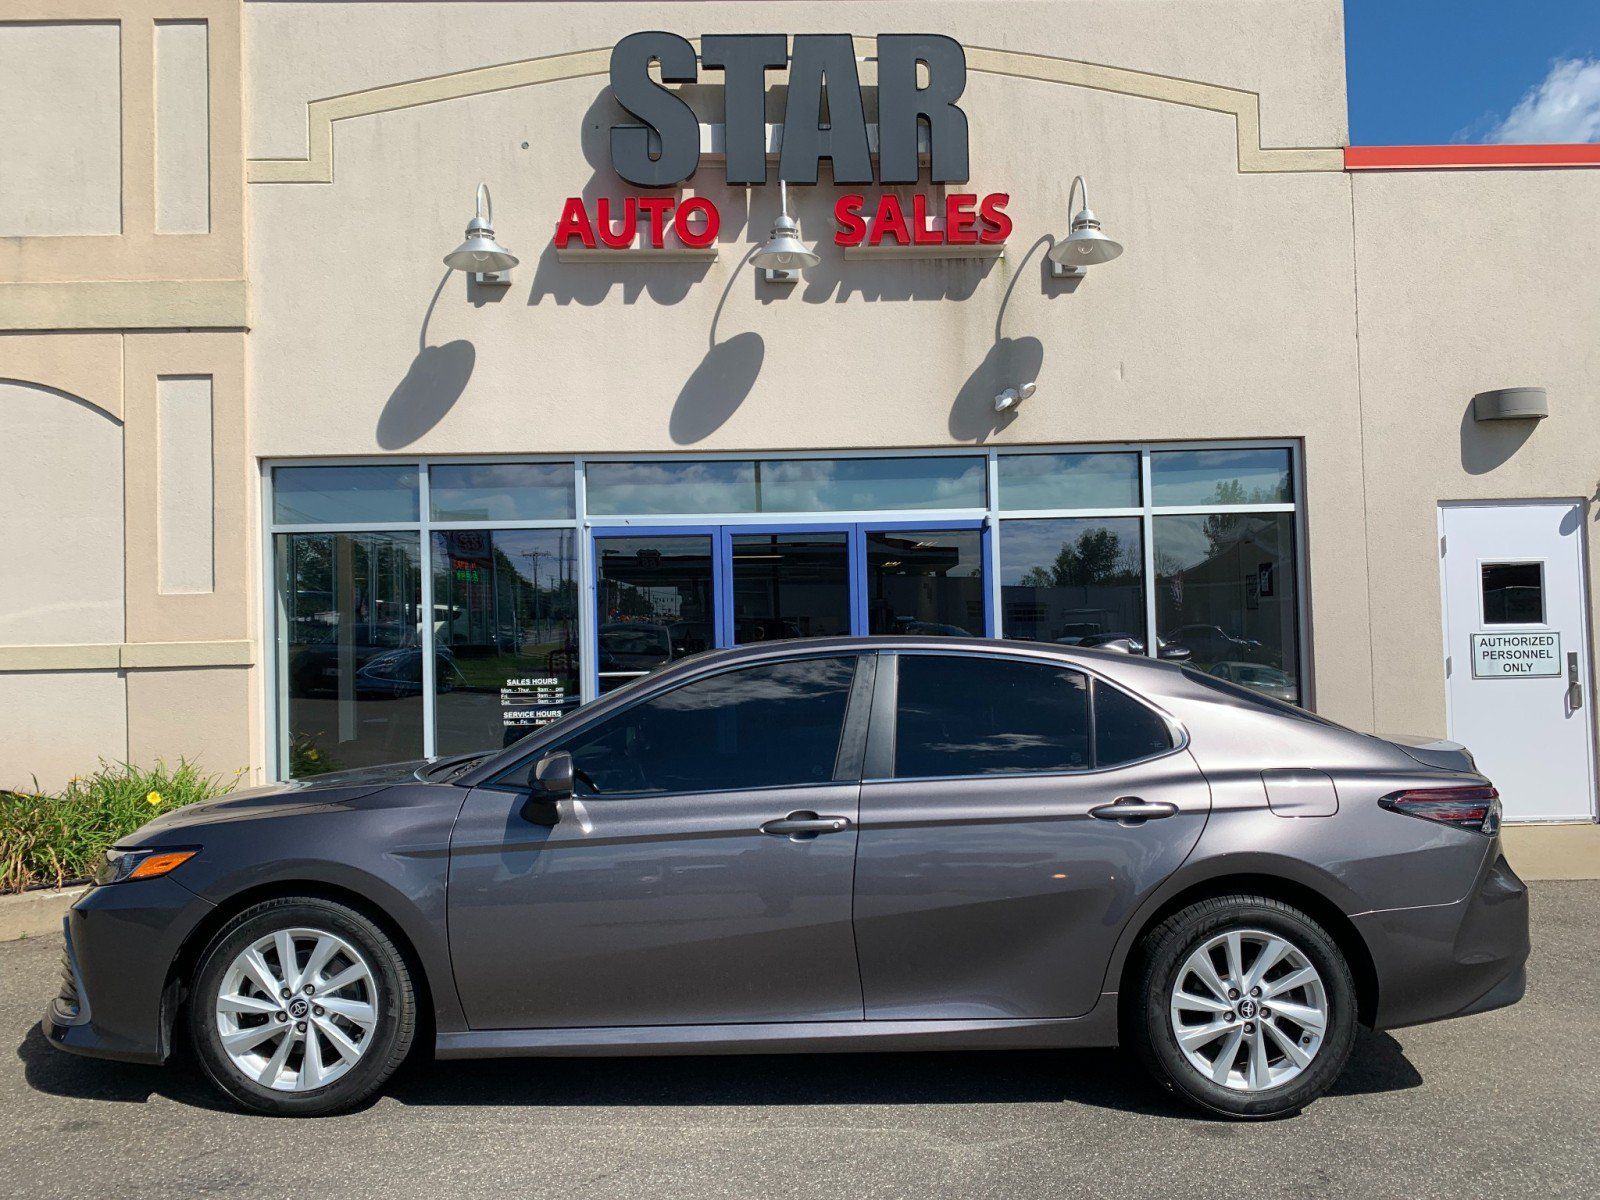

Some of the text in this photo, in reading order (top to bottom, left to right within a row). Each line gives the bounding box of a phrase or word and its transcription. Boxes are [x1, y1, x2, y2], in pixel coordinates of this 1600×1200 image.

[610, 30, 970, 188] STAR
[554, 193, 1013, 249] AUTO SALES
[1480, 636, 1554, 647] AUTHORIZED
[1482, 649, 1553, 660] PERSONNEL
[1503, 663, 1533, 673] ONLY
